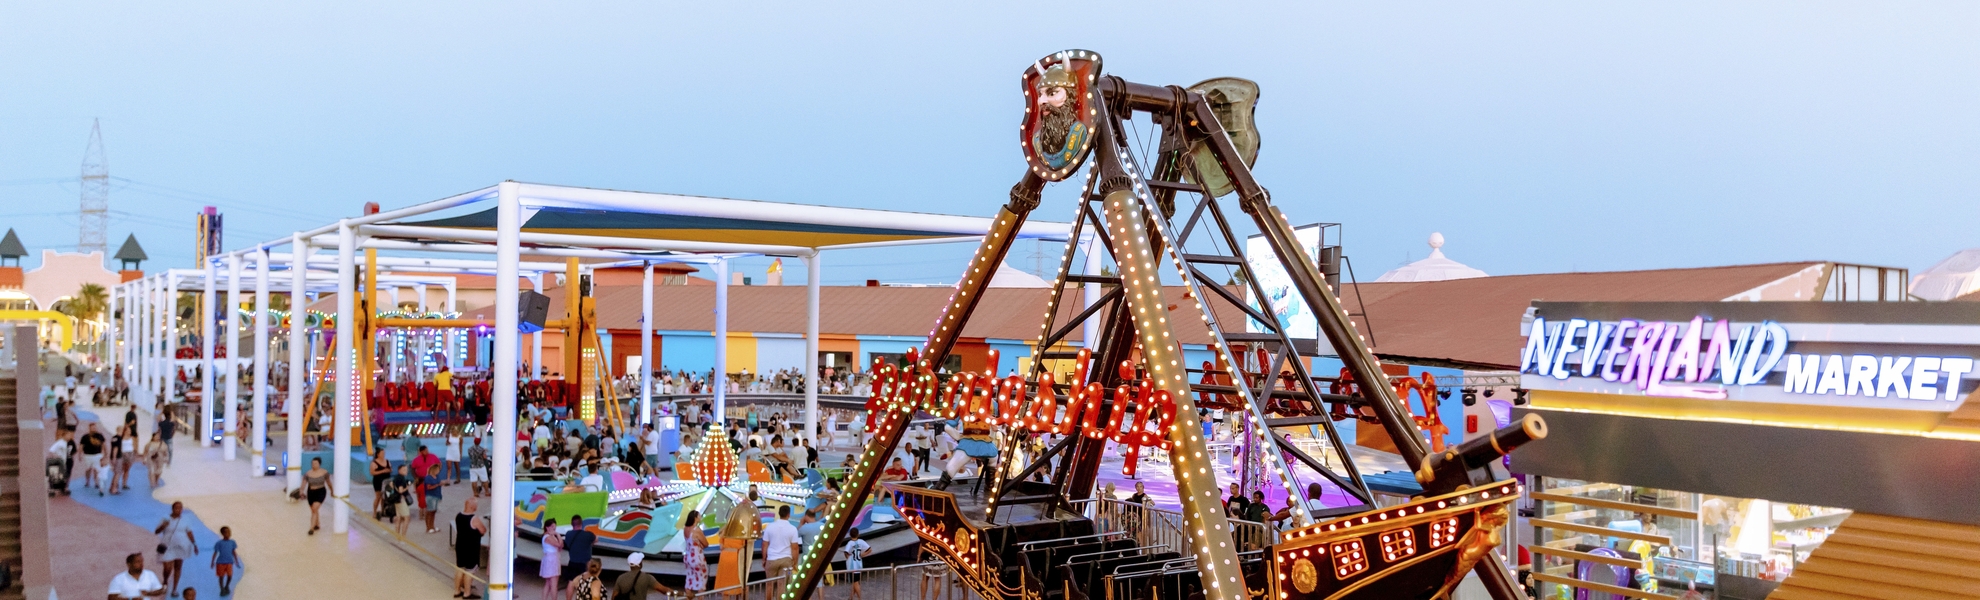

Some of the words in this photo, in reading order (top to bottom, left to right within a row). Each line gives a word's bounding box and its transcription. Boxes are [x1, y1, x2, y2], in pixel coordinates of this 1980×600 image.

[1520, 315, 1789, 400] NEVERLAND
[1783, 353, 1974, 402] MARKET
[852, 548, 862, 562] 10
